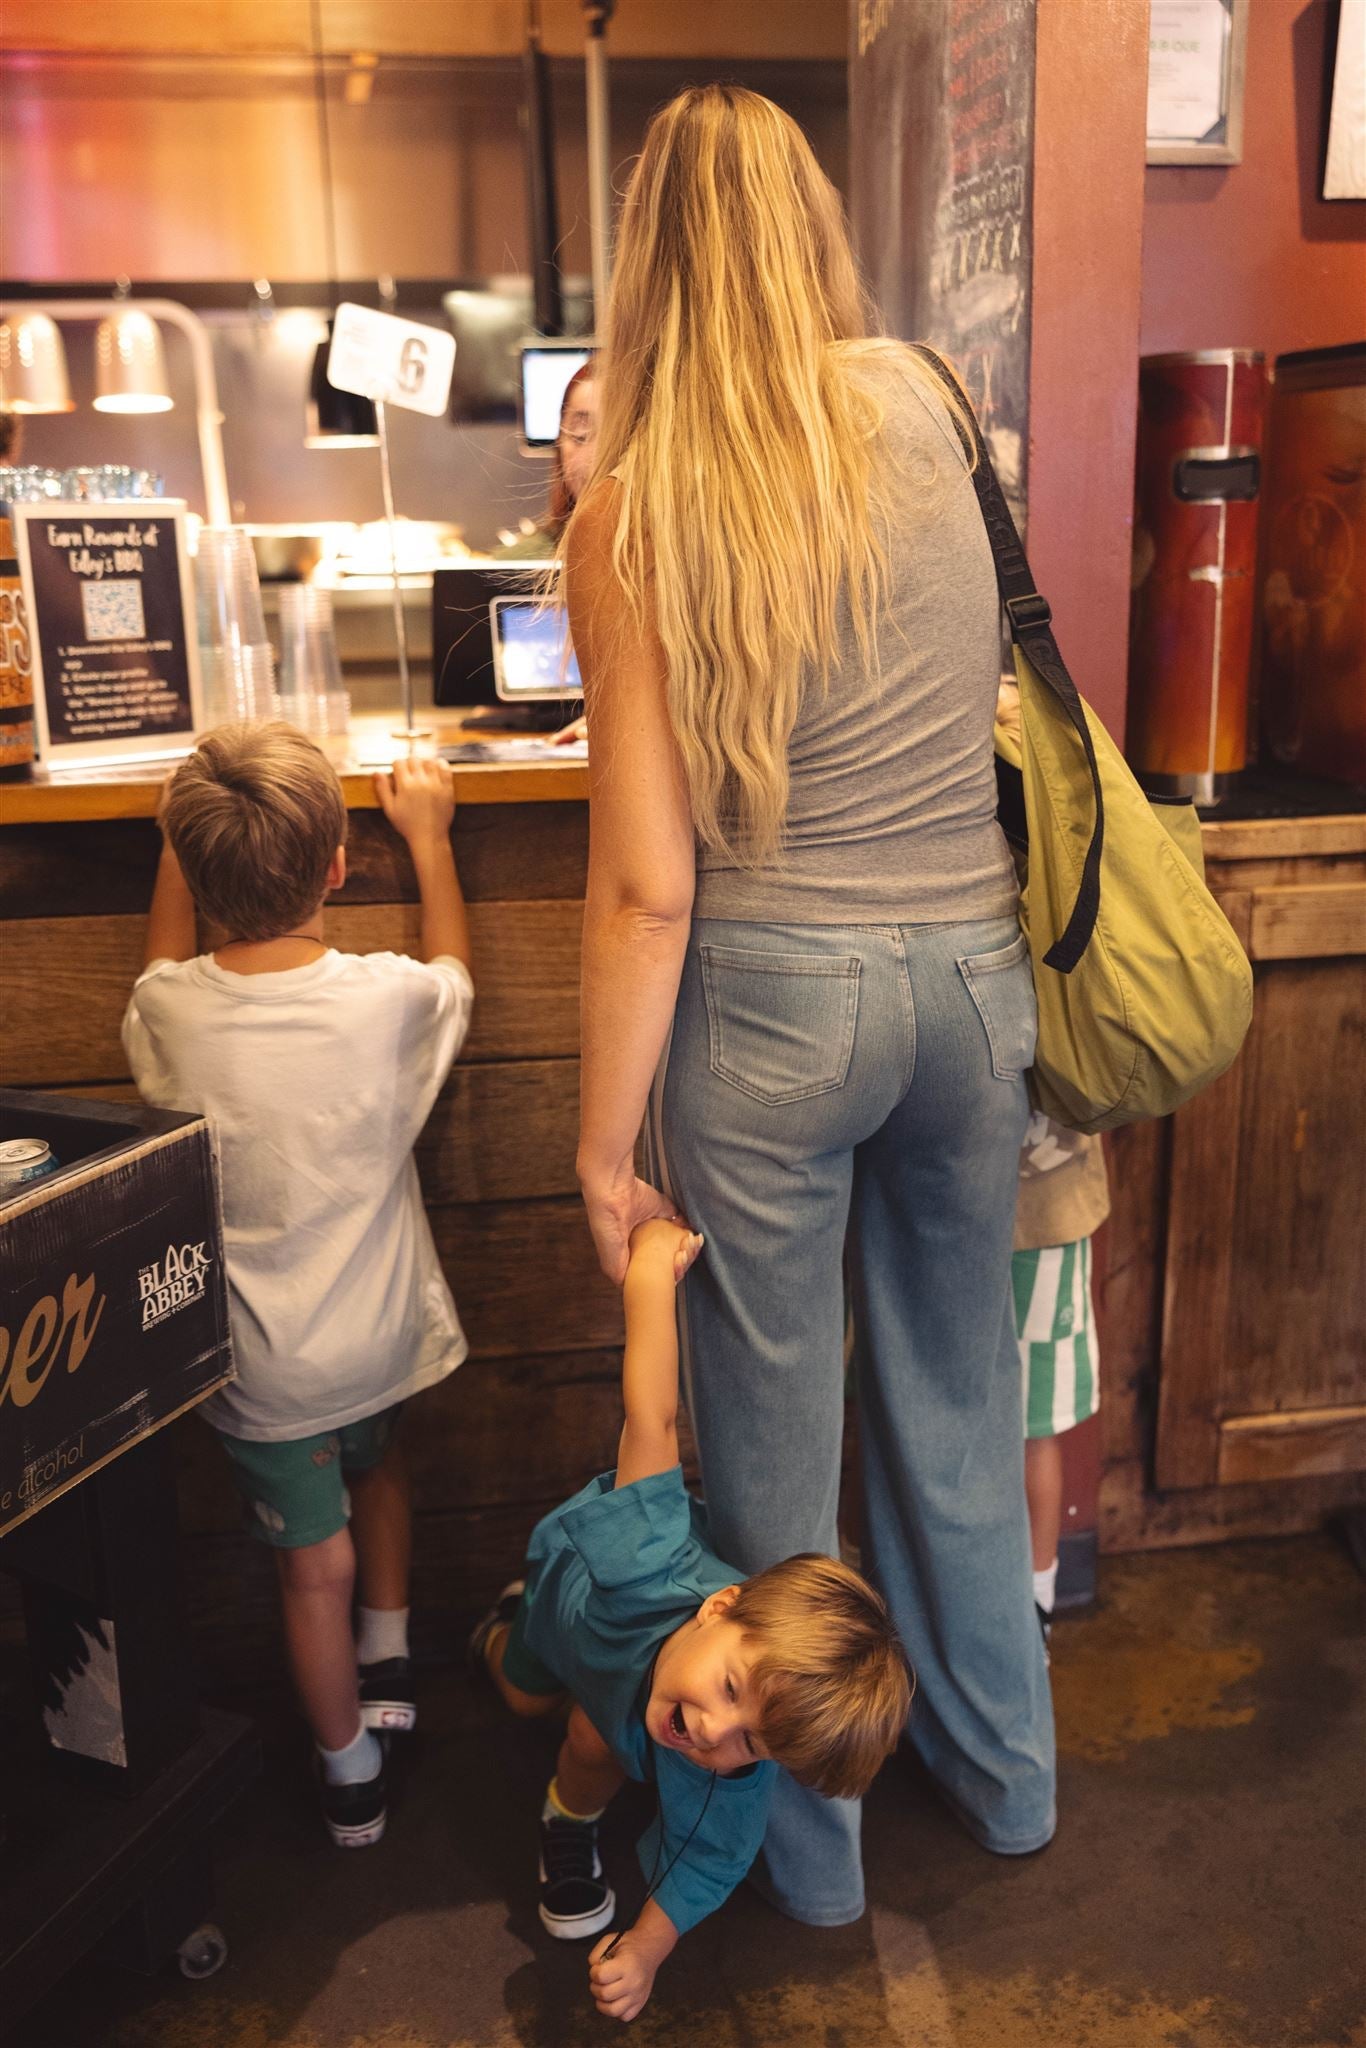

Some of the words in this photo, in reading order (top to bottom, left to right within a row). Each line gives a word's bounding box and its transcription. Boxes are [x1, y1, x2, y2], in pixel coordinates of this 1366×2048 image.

[398, 337, 427, 394] 6
[138, 1241, 214, 1301] BLACK
[142, 1264, 208, 1324] ABBEY
[18, 1434, 84, 1500] alcohol
